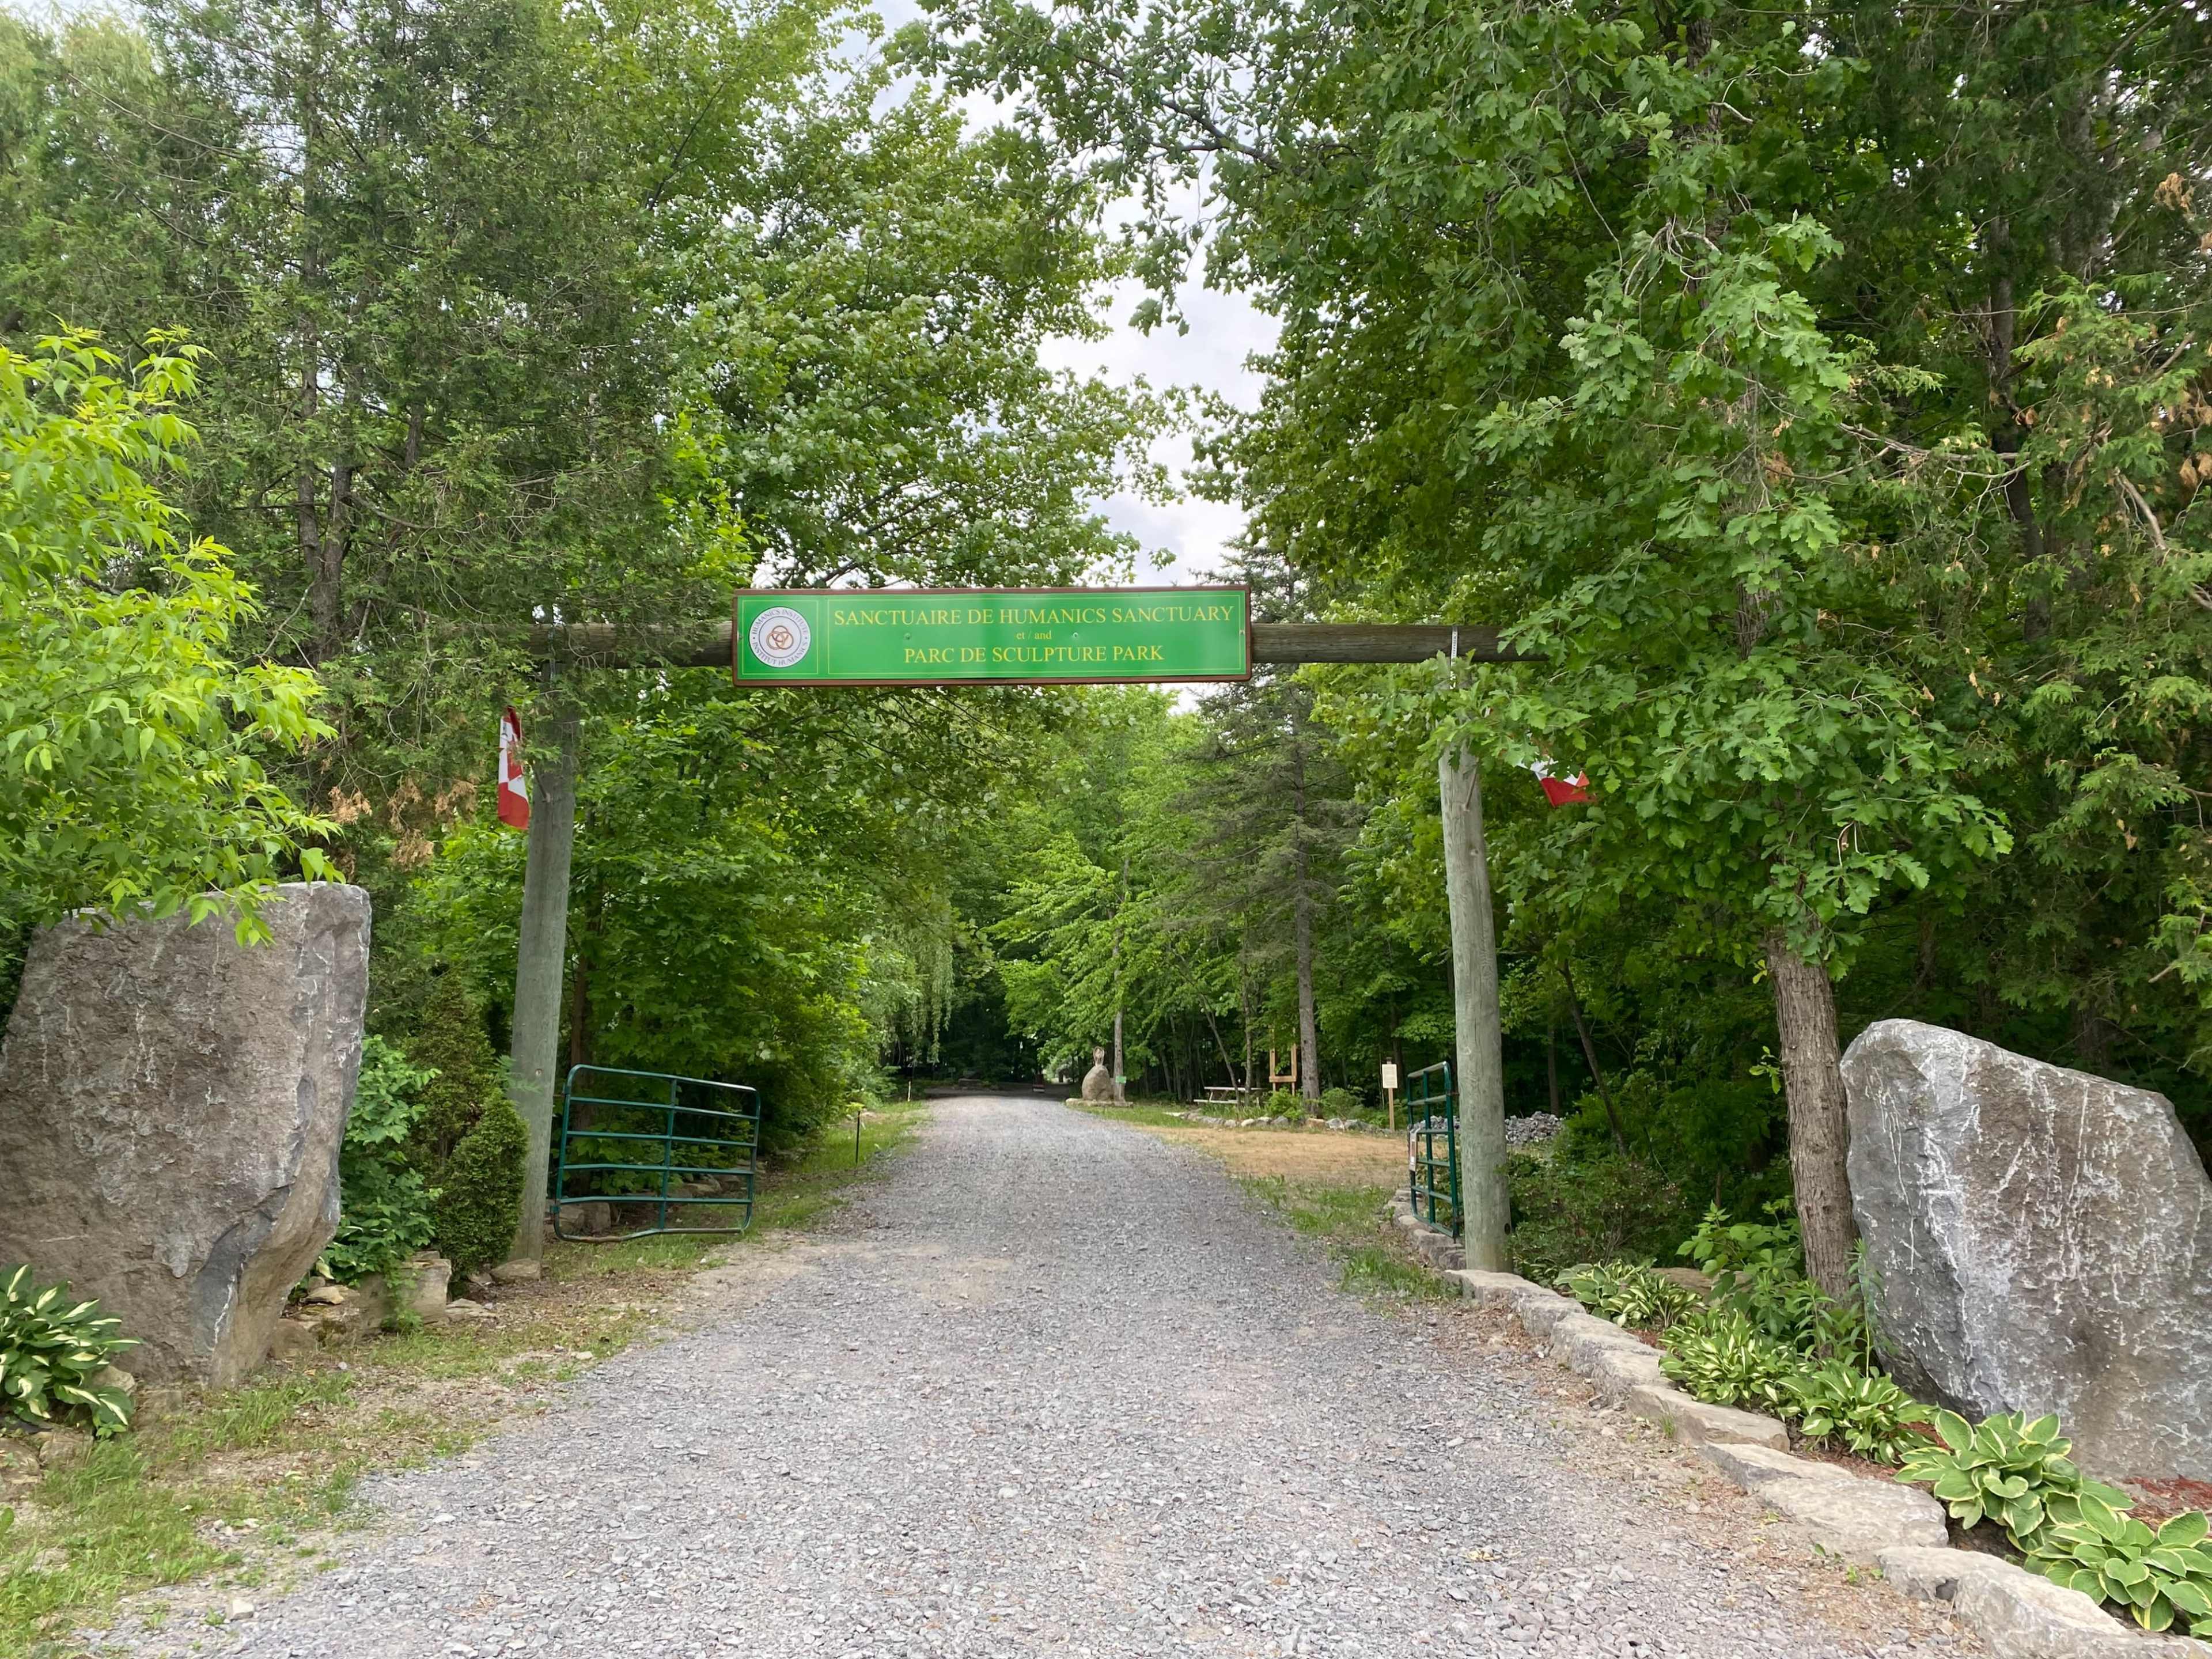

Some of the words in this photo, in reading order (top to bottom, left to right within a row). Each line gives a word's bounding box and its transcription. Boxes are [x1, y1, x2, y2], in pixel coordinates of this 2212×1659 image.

[752, 609, 780, 635] HUMANICS
[782, 609, 808, 635] INSTITUTE
[834, 610, 961, 626] SANCTUAIRE
[968, 609, 994, 624] DE
[1000, 608, 1106, 624] HUMANICS
[1112, 607, 1234, 623] SANCTUARY
[1016, 631, 1025, 639] et
[1034, 630, 1052, 639] and
[904, 648, 953, 663] PARC
[960, 647, 986, 662] DE
[992, 646, 1107, 662] SCULPTURE
[1112, 645, 1165, 661] PARK
